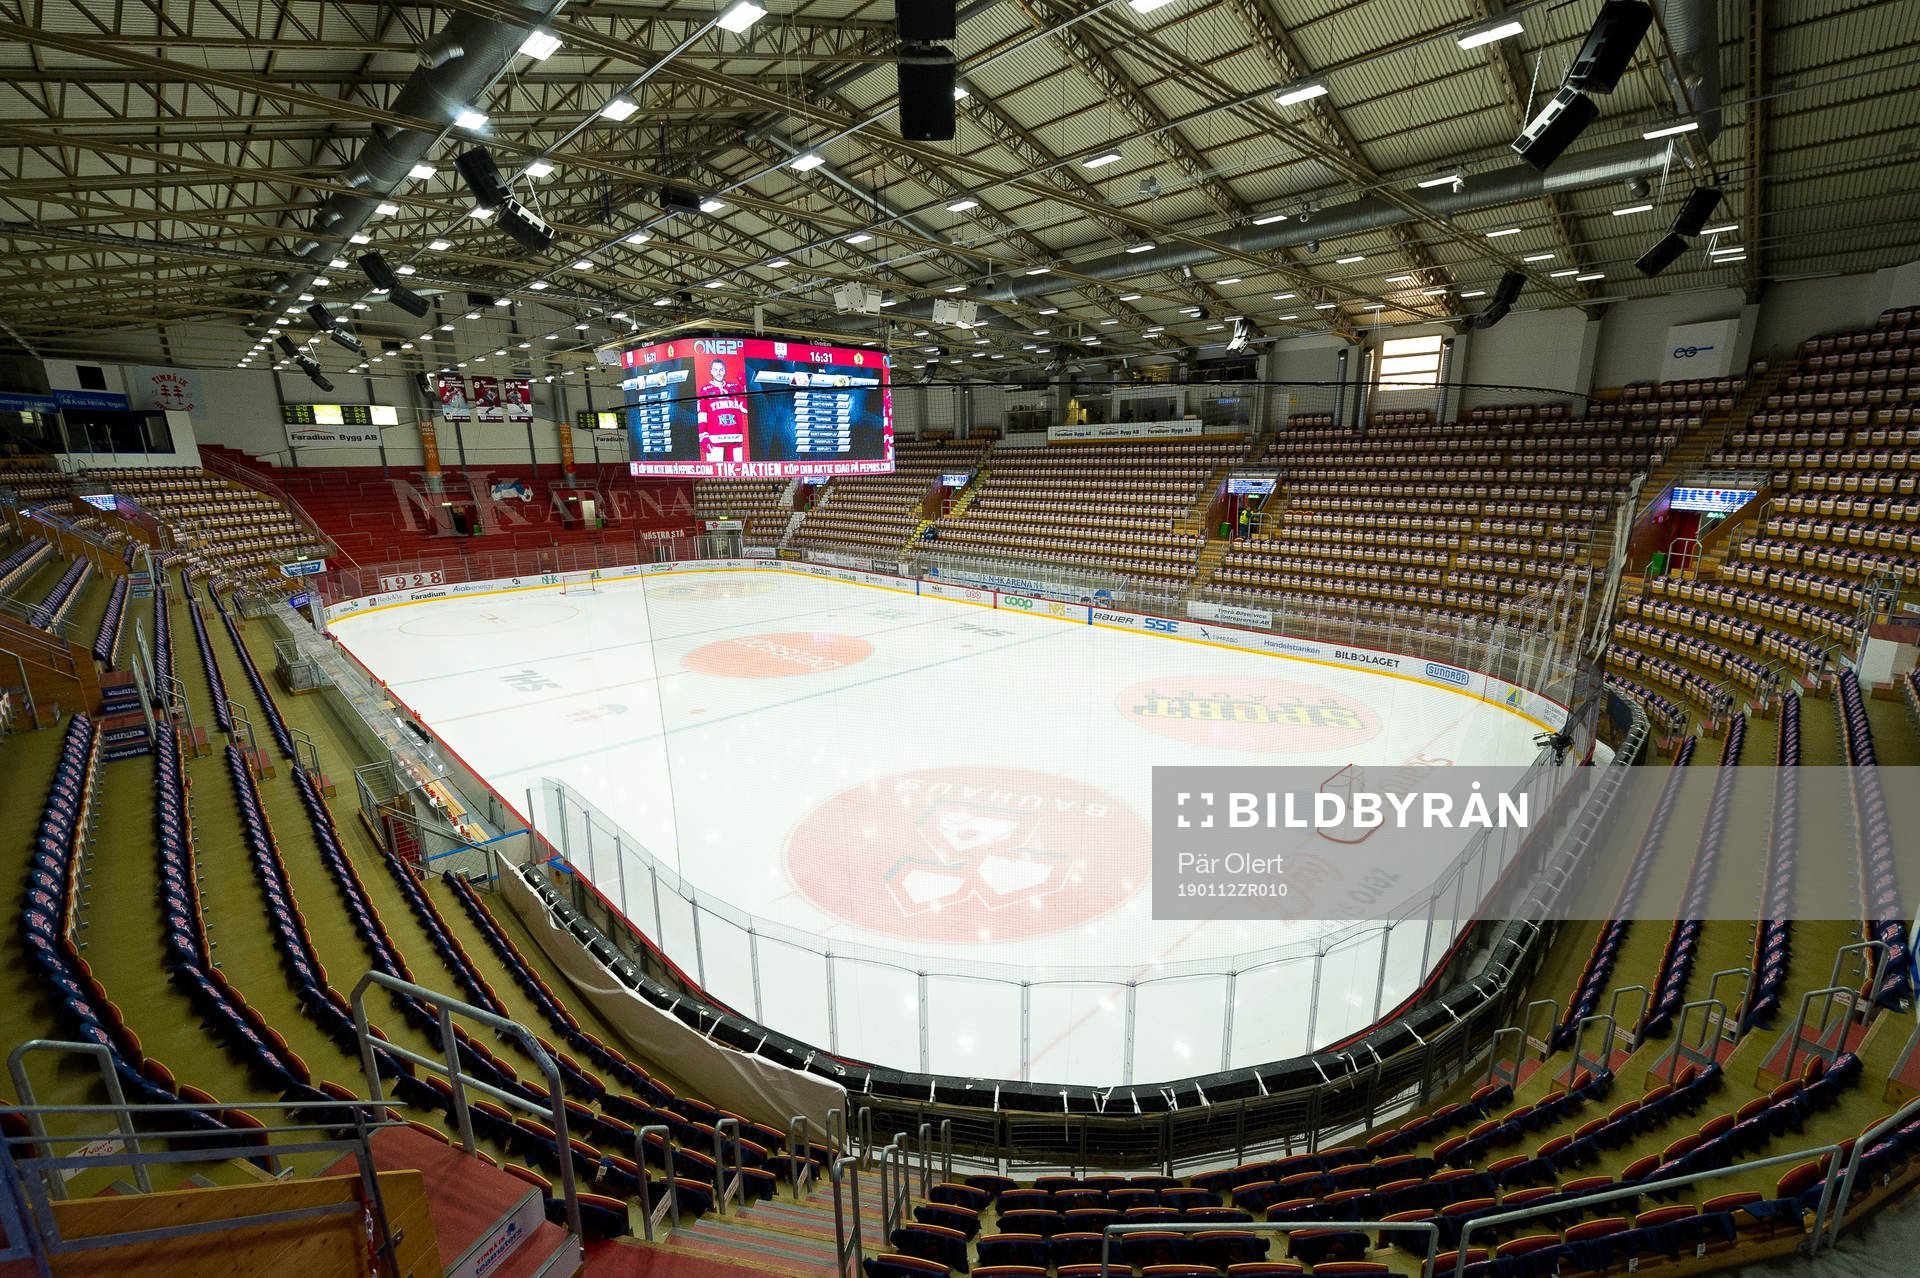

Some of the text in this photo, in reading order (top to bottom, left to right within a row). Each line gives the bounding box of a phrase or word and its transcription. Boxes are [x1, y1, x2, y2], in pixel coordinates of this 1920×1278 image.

[810, 352, 833, 363] 16:31
[339, 434, 362, 442] Bygg
[716, 462, 782, 477] TIK-AKTIEN
[784, 463, 799, 475] KÖP
[814, 464, 834, 474] AKTIE
[834, 464, 850, 473] IDAG
[851, 461, 860, 473] PÅ
[643, 528, 685, 540] VÄSTRA STÅ
[1006, 578, 1033, 590] ARENA
[410, 590, 446, 601] Faradium
[1004, 595, 1034, 610] coop
[1143, 617, 1180, 633] SSE
[1264, 639, 1321, 656] Handelsbanken
[1334, 649, 1400, 669] BILBOLAGET
[893, 778, 1110, 818] BAUHAUS
